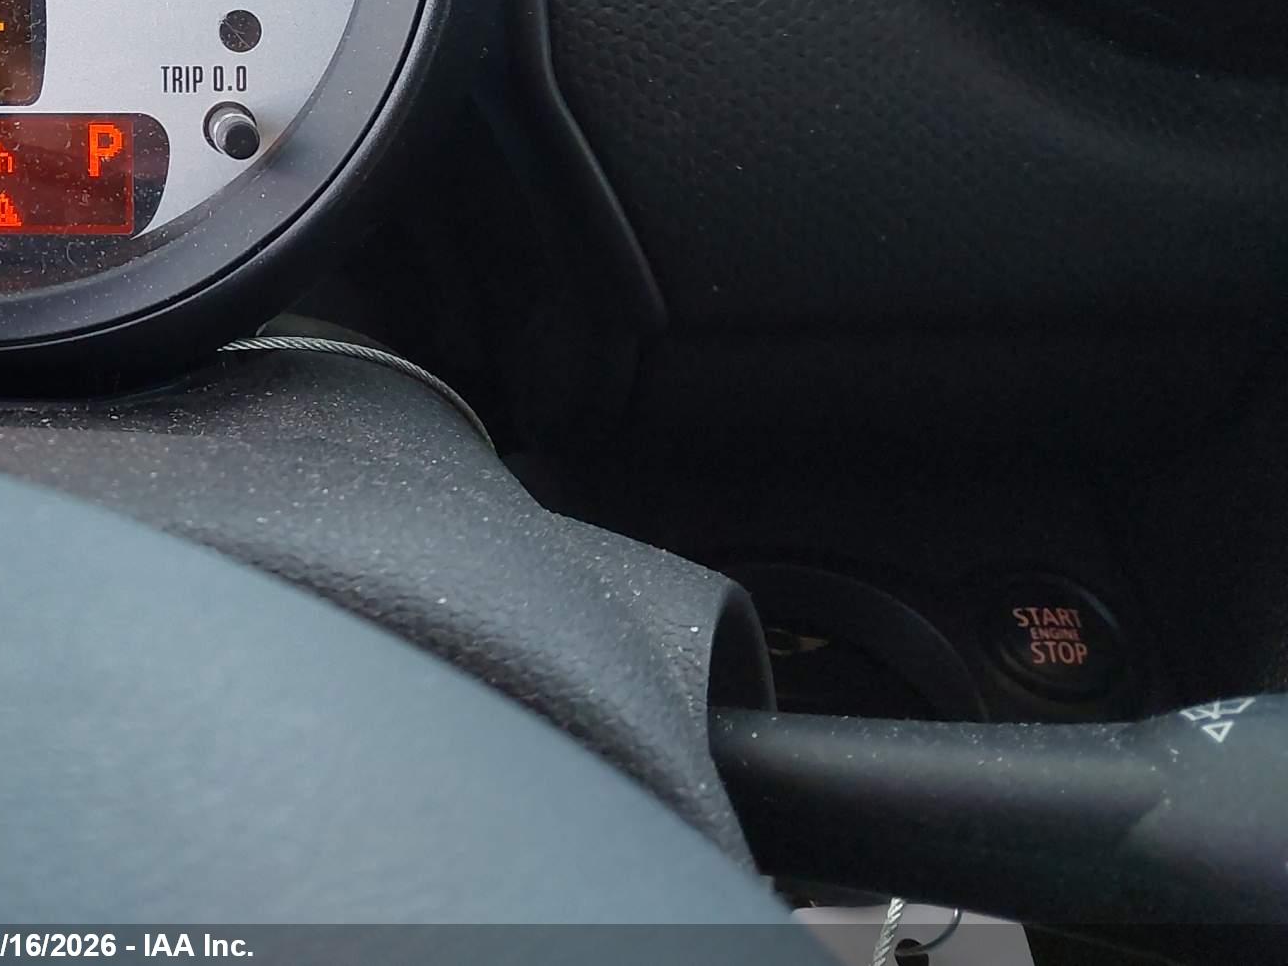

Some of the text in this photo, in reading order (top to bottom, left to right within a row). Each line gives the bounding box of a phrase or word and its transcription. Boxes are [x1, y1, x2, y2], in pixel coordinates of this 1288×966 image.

[161, 65, 248, 93] TRIP 0.0
[87, 122, 124, 177] P
[1012, 607, 1082, 628] START
[1030, 627, 1081, 641] ENGINE
[1030, 640, 1088, 665] STOP
